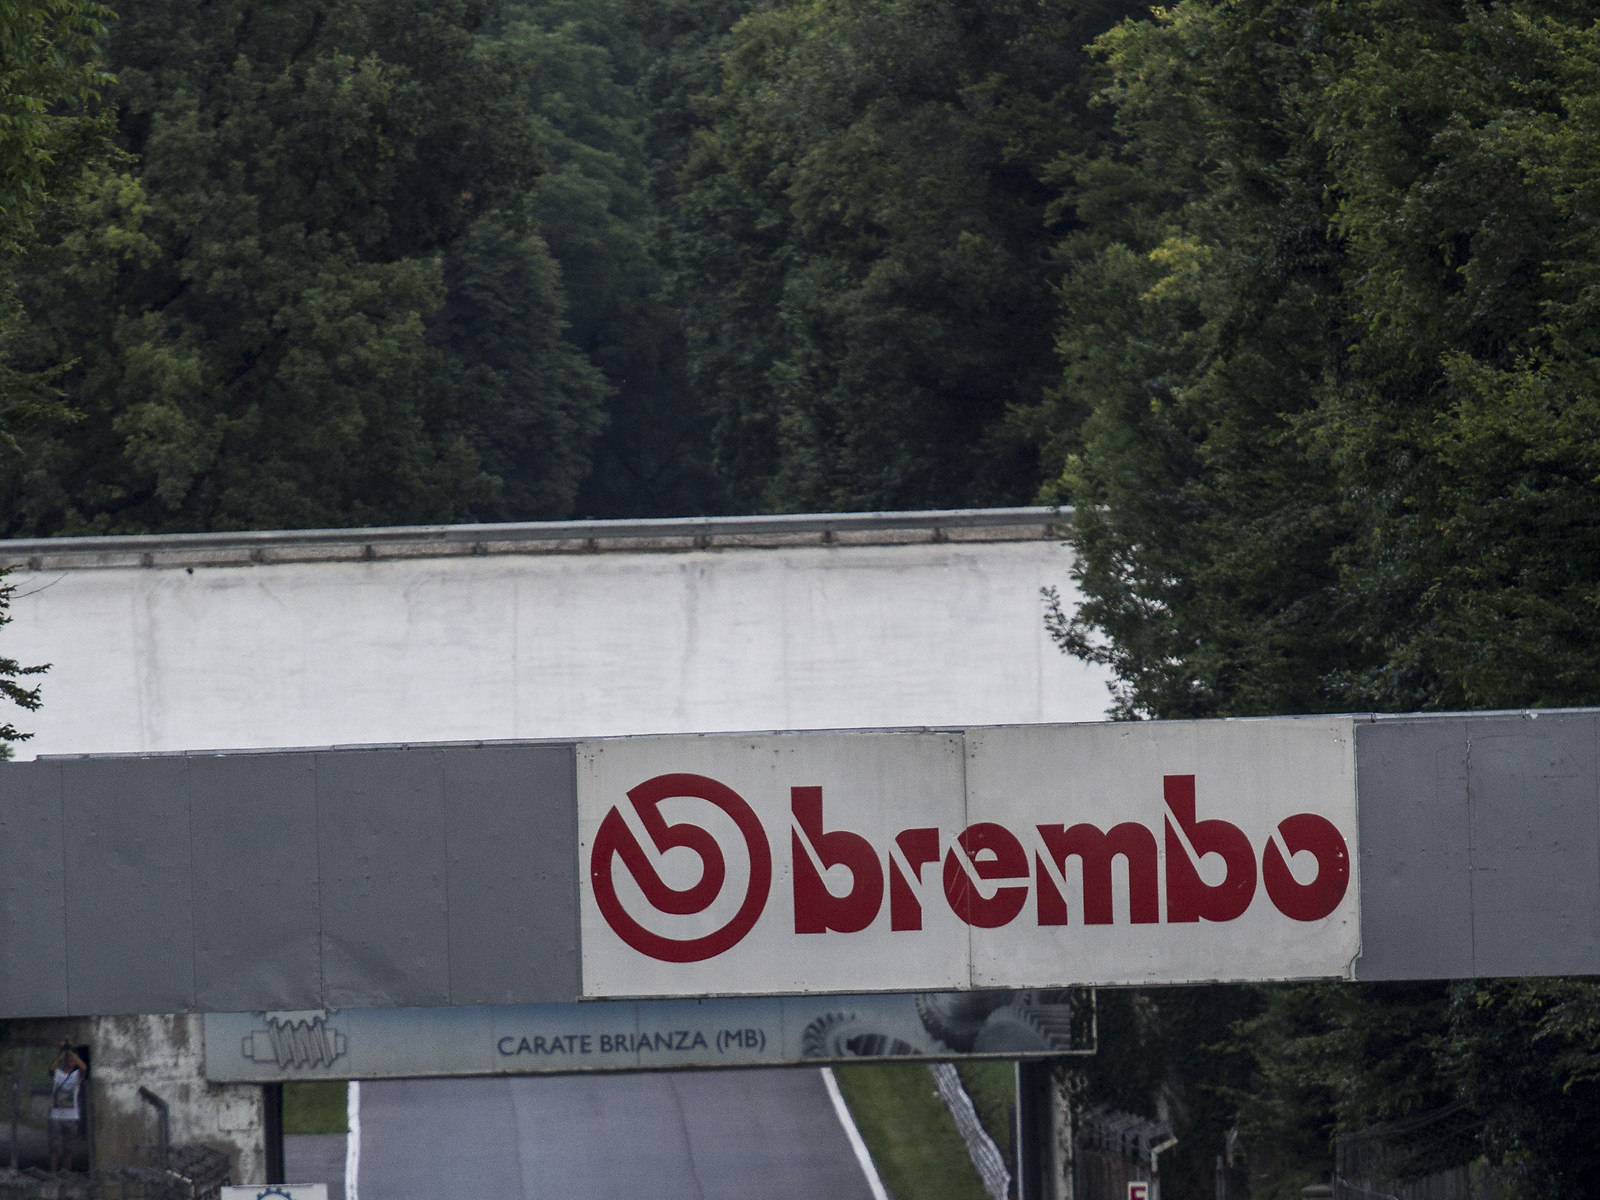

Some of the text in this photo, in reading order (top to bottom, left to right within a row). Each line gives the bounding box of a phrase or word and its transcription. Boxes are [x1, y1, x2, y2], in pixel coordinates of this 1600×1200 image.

[791, 774, 1350, 935] brembo
[497, 1028, 767, 1057] CARATE BRIANZA (MB)
